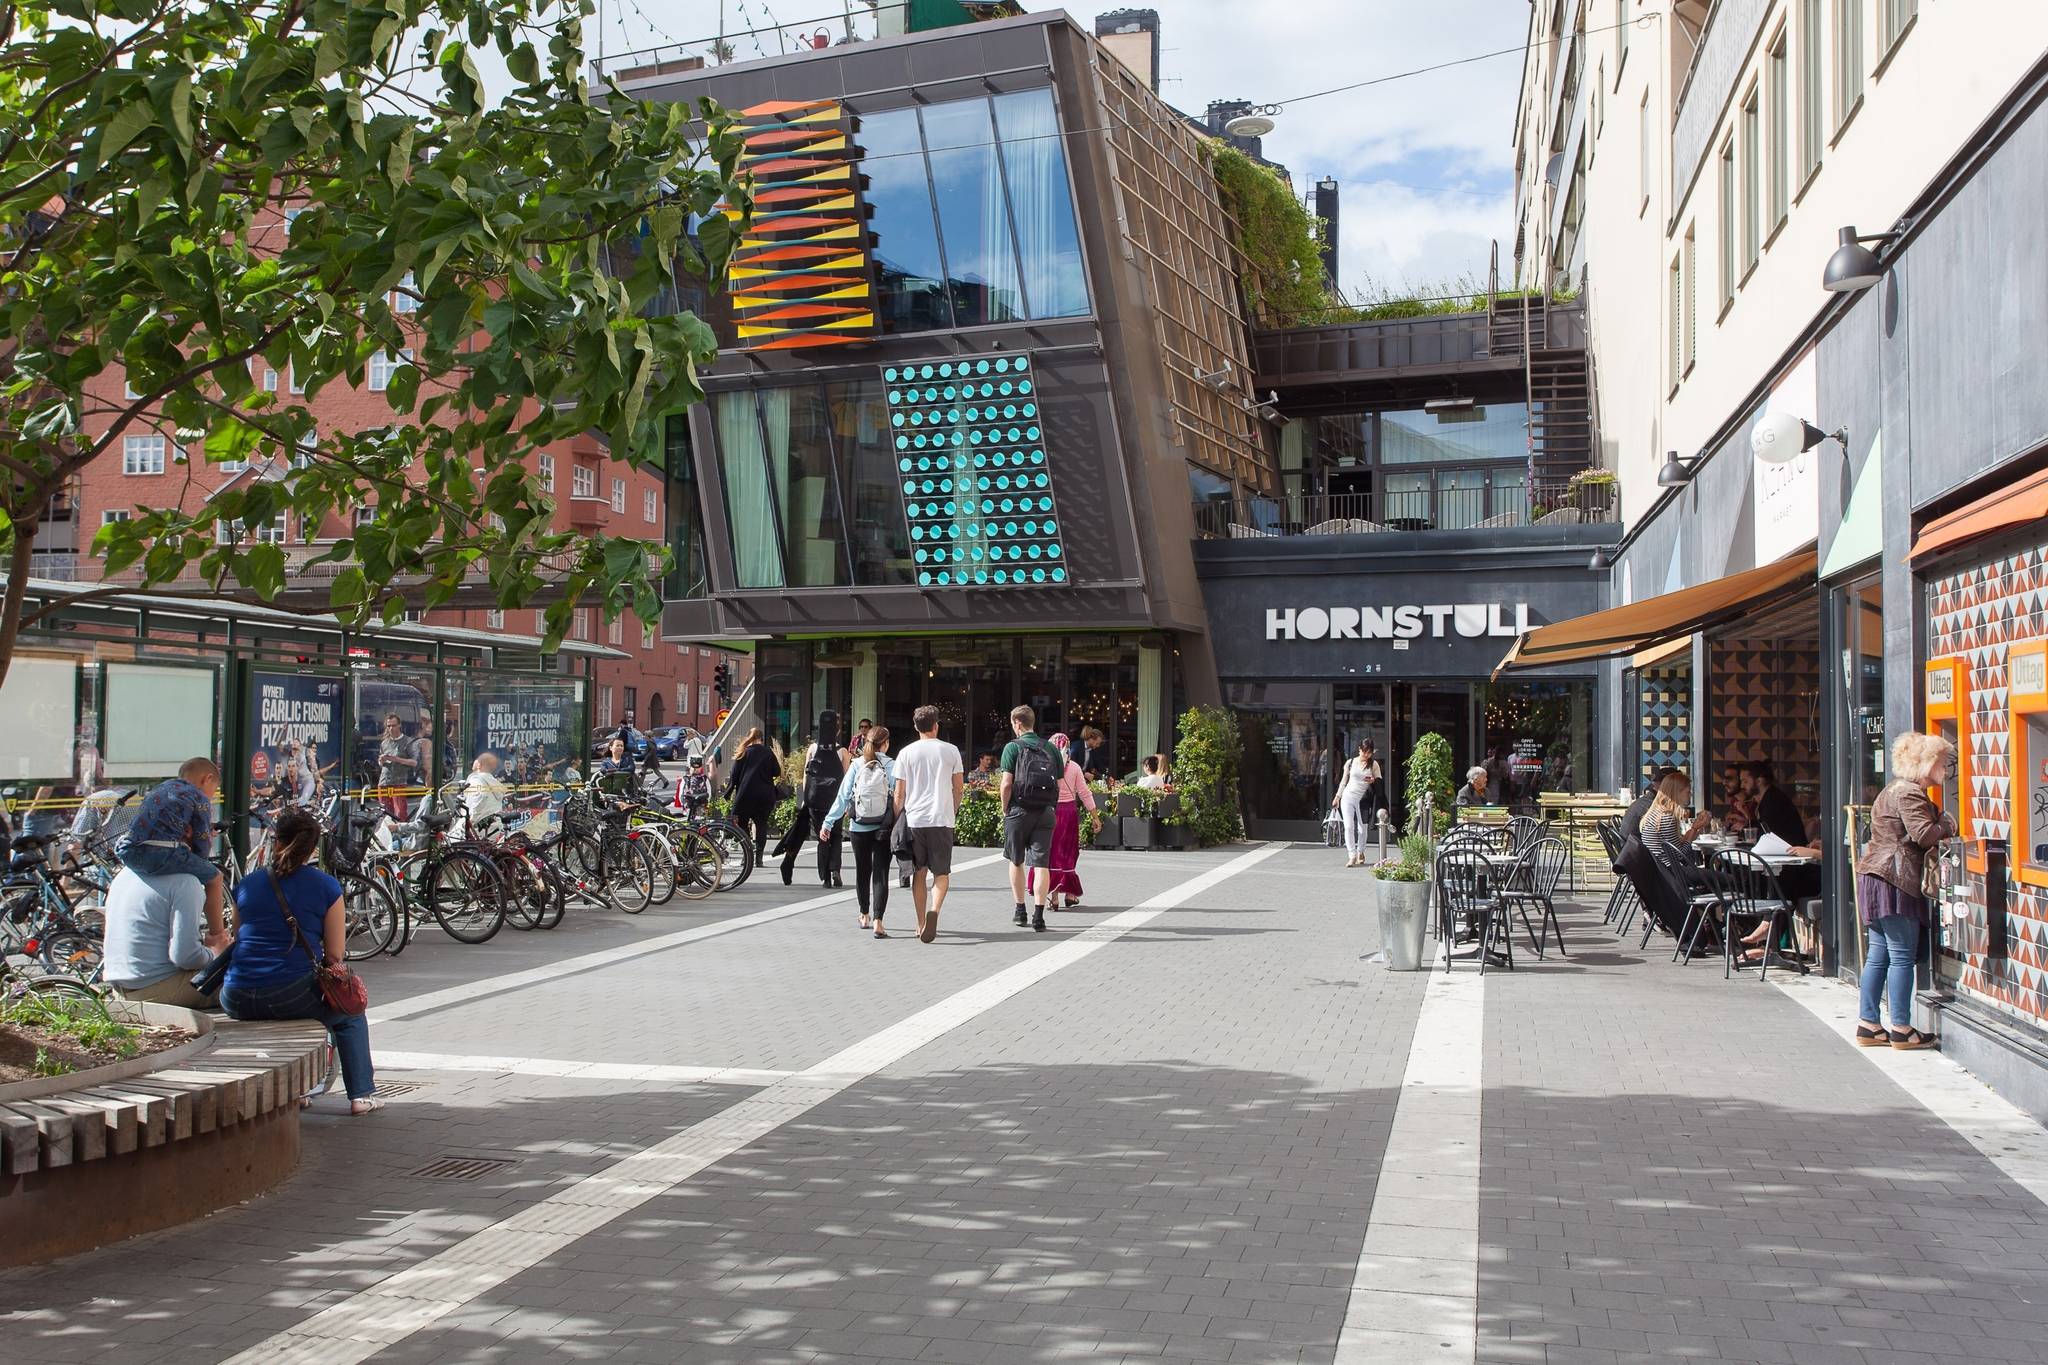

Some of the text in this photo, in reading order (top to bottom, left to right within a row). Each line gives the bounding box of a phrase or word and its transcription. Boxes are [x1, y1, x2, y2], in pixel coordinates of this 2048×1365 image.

[1266, 603, 1543, 640] HORNSTULL
[2014, 655, 2043, 690] Uttag
[262, 684, 285, 699] NYHET!
[1930, 672, 1951, 700] Uttag
[262, 698, 331, 722] GARLIC FUSION
[487, 713, 560, 730] GARLIC FUSION
[261, 723, 329, 747] PIZZATOPPING
[487, 729, 557, 749] PIZZATOPPING
